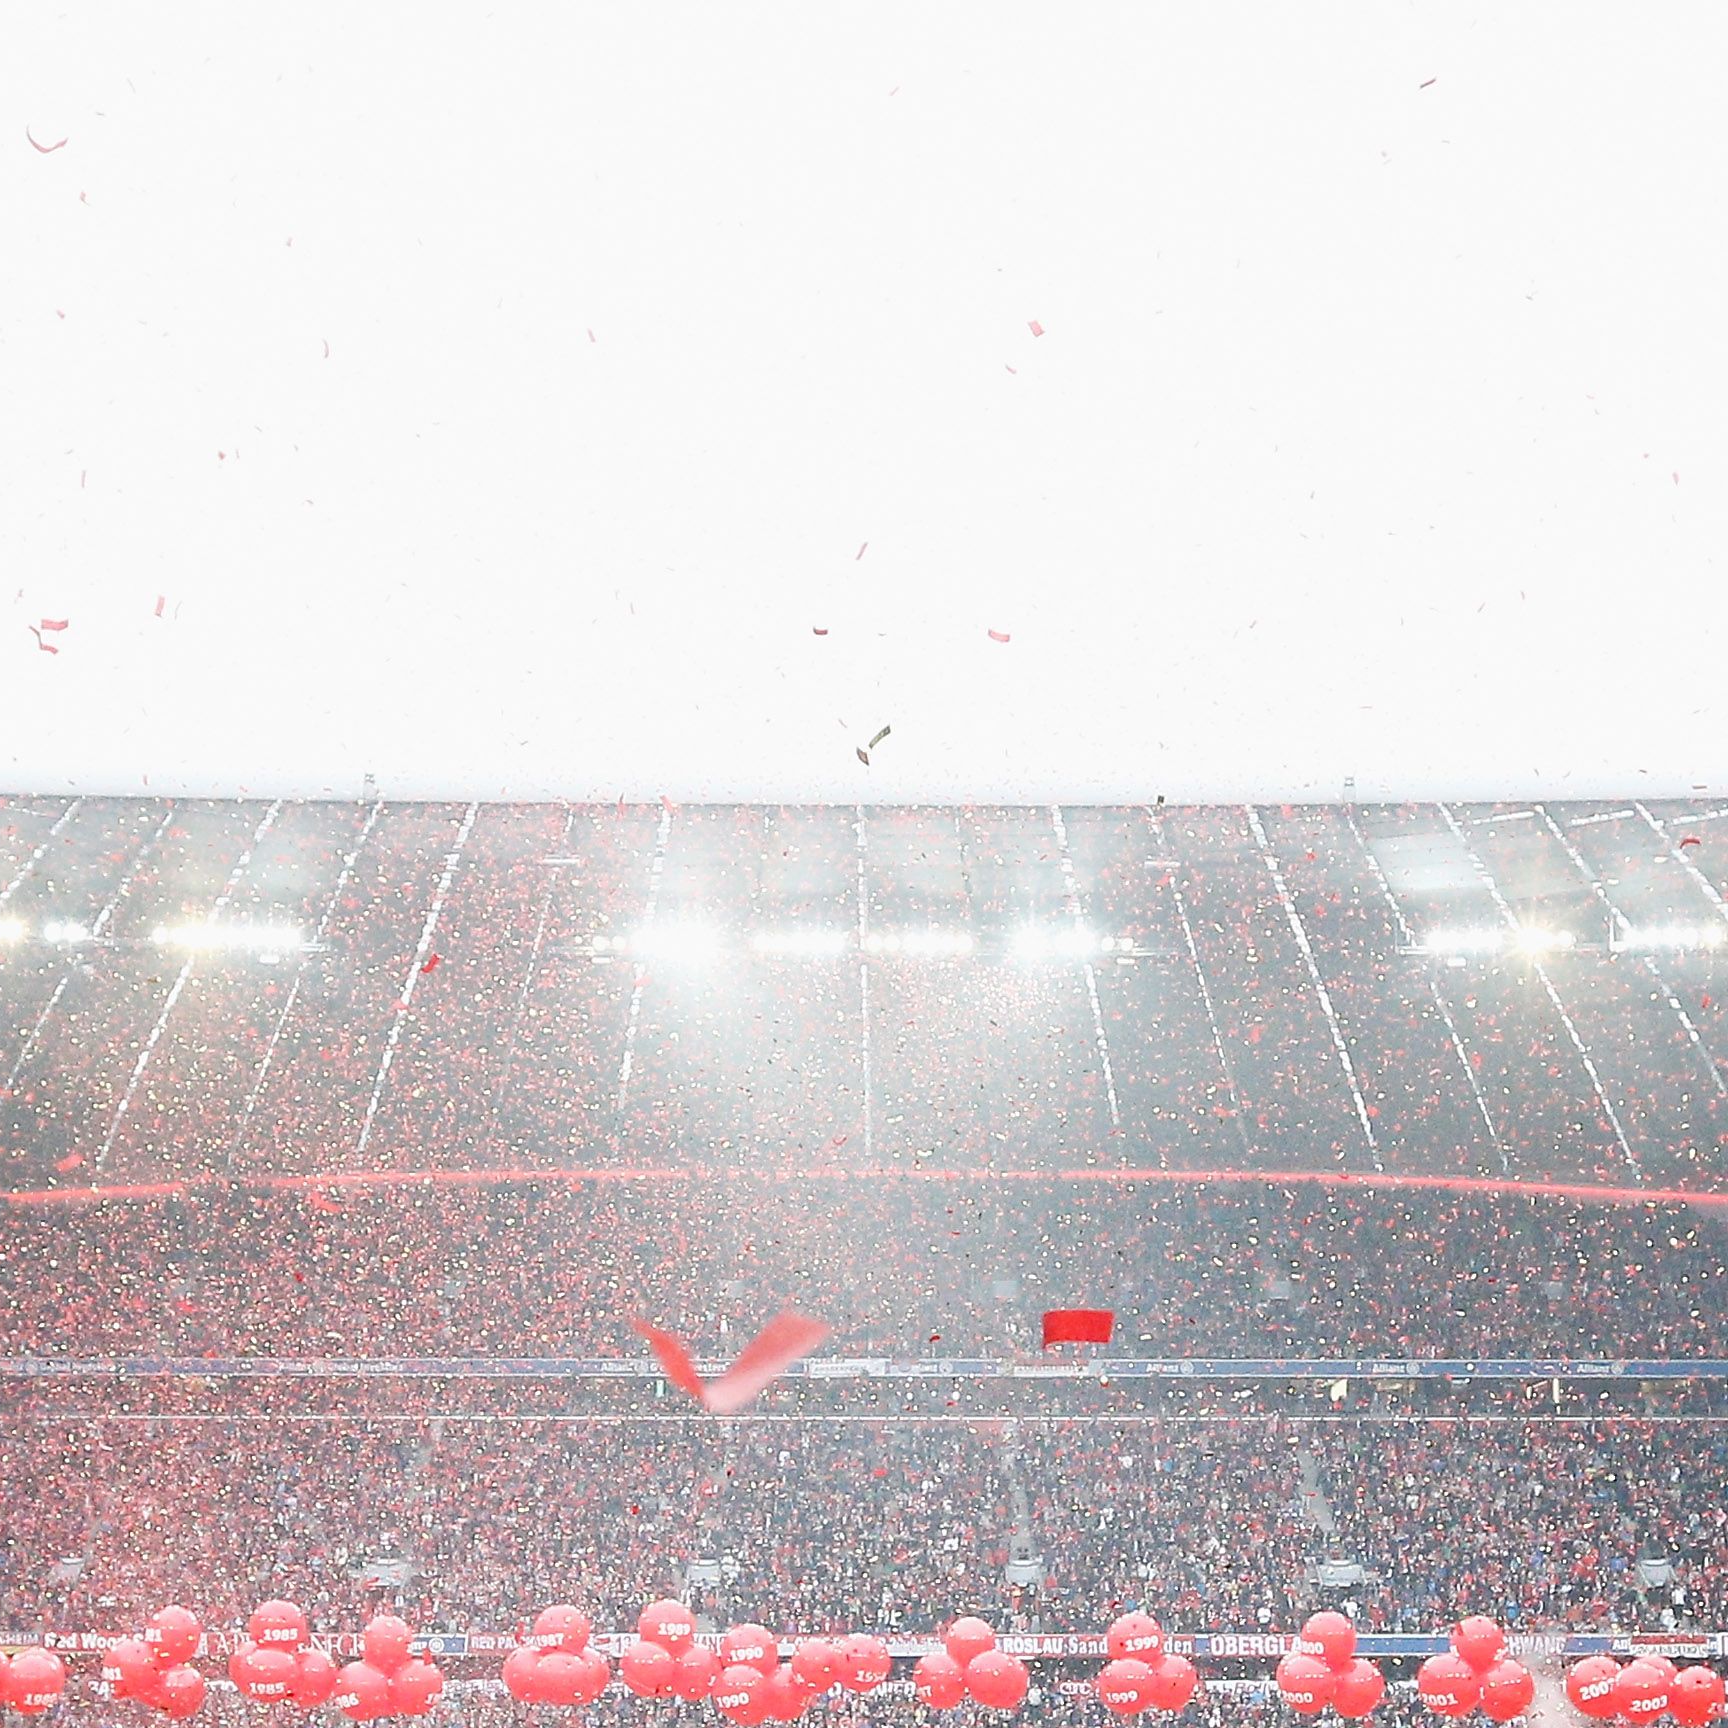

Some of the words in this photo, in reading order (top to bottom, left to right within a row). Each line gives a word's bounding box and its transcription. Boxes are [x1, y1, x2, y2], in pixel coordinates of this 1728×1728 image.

[262, 1628, 298, 1642] 1985
[658, 1622, 691, 1636] 1989
[1125, 1636, 1160, 1651] 1999
[729, 1646, 764, 1662] 1990
[248, 1682, 286, 1695] 1985
[715, 1692, 751, 1709] 1990
[1105, 1690, 1139, 1704] 1999
